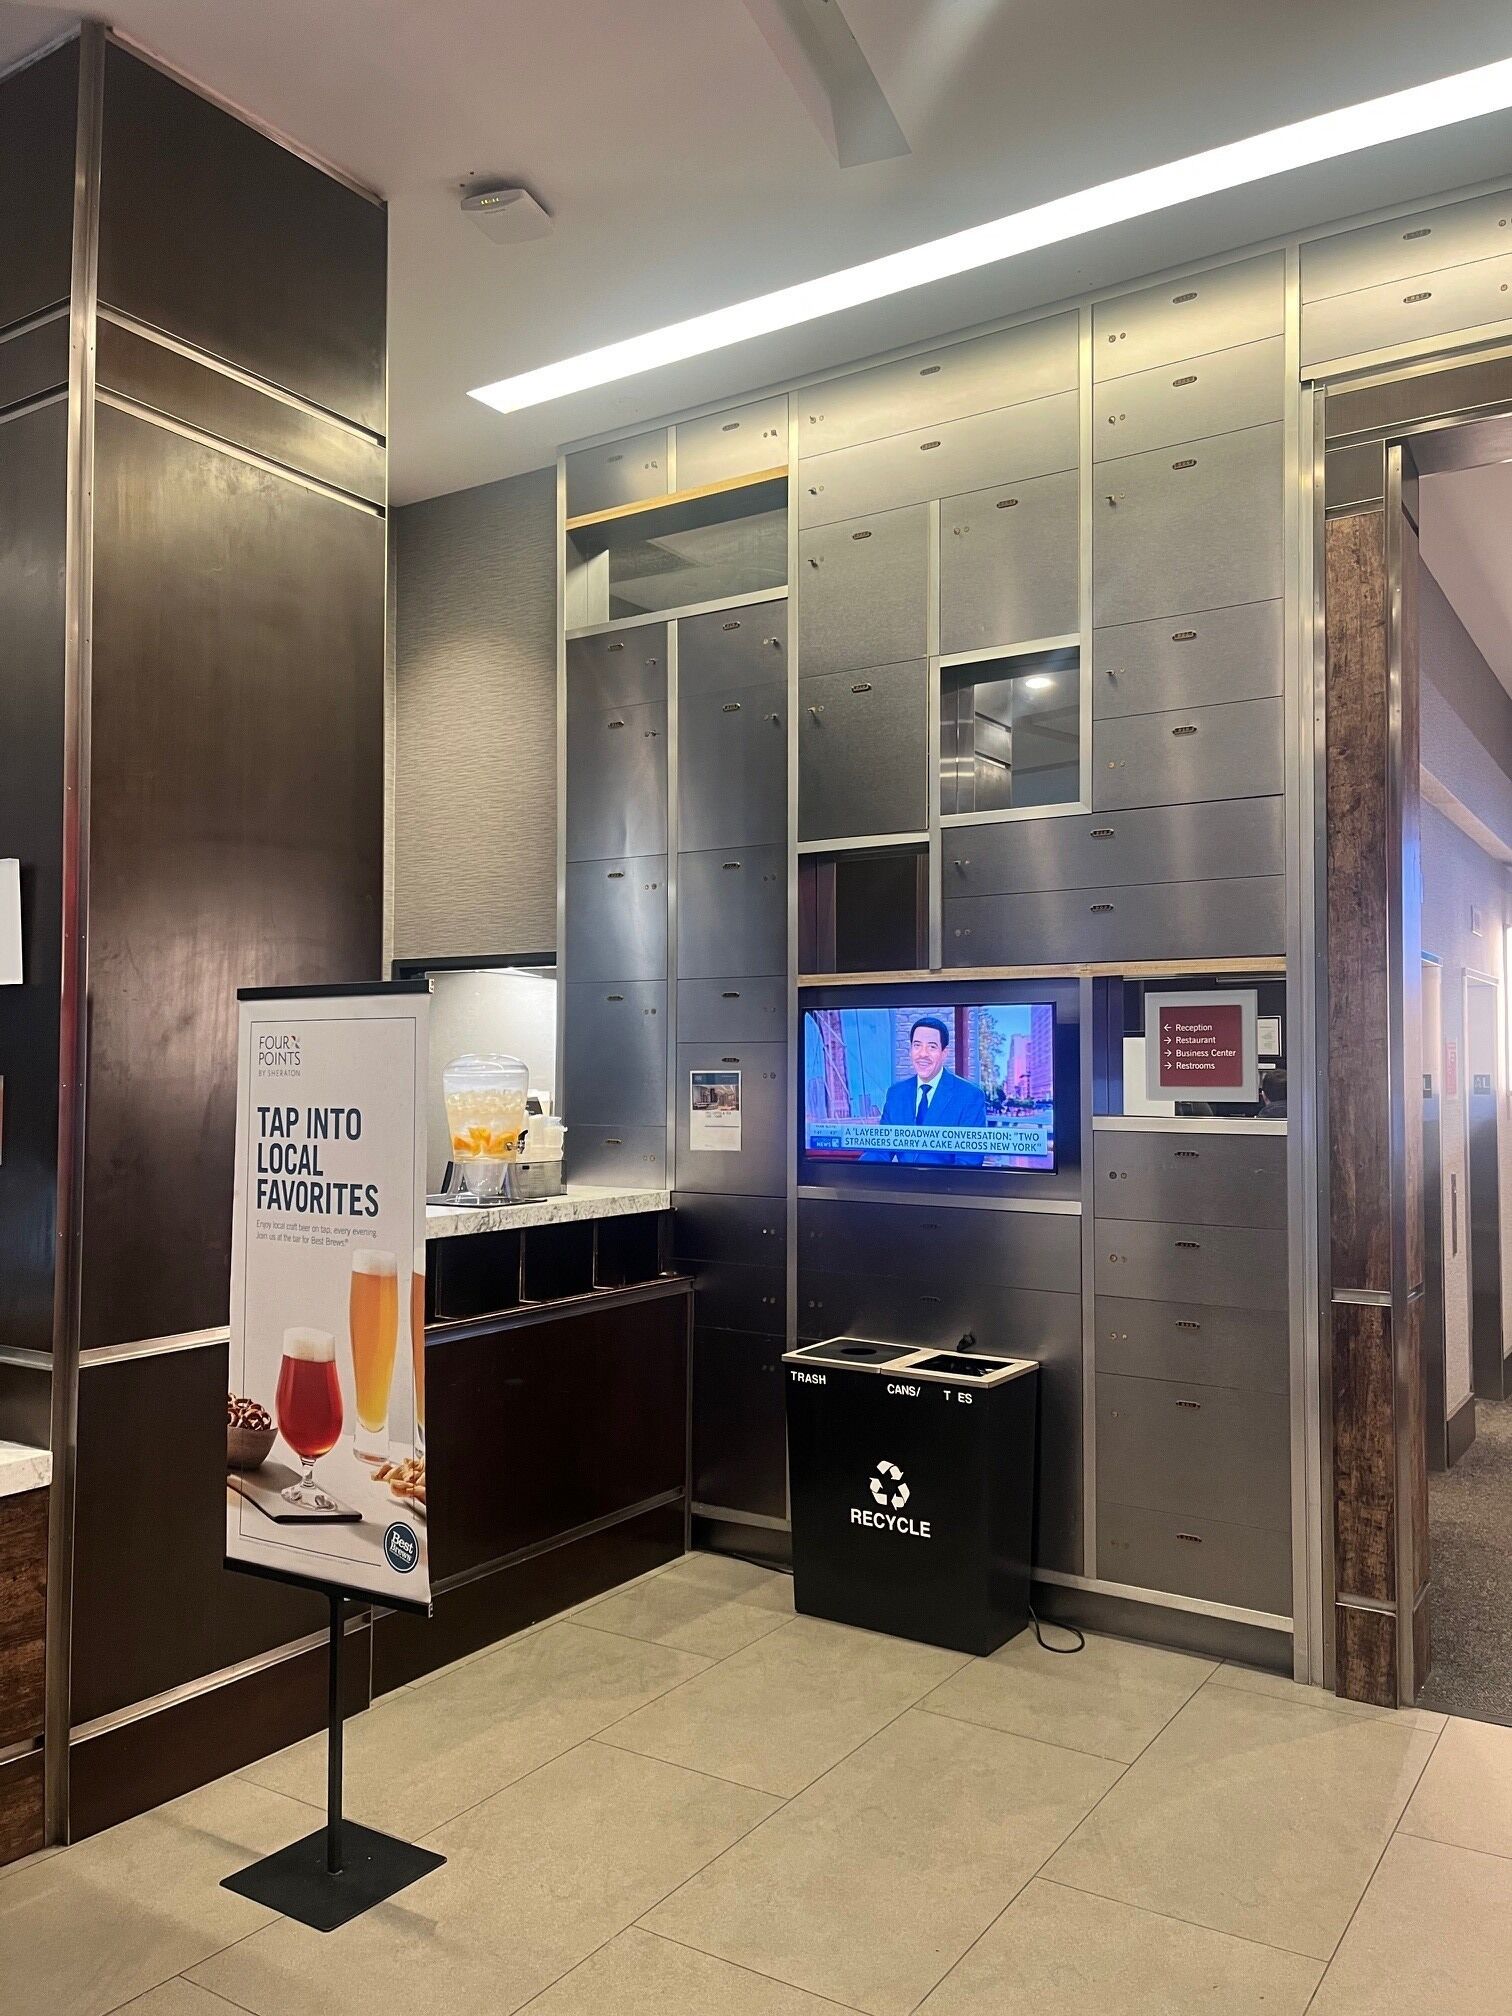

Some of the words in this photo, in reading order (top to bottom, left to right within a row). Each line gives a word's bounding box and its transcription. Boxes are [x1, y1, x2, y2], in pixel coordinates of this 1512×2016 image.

[1175, 1023, 1213, 1033] Reception
[259, 1035, 290, 1050] FOUR
[1175, 1036, 1216, 1044] Restaurant
[258, 1051, 301, 1066] POINTS
[1175, 1049, 1209, 1057] Business
[1211, 1049, 1236, 1057] Center
[1176, 1061, 1216, 1070] Restrooms
[258, 1069, 265, 1077] BY
[267, 1069, 301, 1078] SHERATON
[257, 1106, 299, 1138] TAP
[306, 1107, 362, 1141] INTO
[845, 1128, 851, 1136] A
[894, 1129, 940, 1139] BROADWAY
[942, 1130, 1012, 1141] CONVERSATION:
[845, 1137, 891, 1147] STRANGERS
[893, 1139, 919, 1148] CARRY
[921, 1140, 928, 1148] A
[930, 1140, 952, 1149] CAKE
[954, 1141, 988, 1150] ACROSS
[990, 1142, 1010, 1151] NEW
[257, 1142, 324, 1177] LOCAL
[257, 1178, 379, 1218] FAVORITES
[256, 1220, 271, 1230] Enjoy
[273, 1220, 285, 1230] local
[286, 1222, 297, 1231] craft
[299, 1223, 310, 1232] beer
[333, 1228, 351, 1236] every
[283, 1233, 291, 1242] the
[293, 1235, 301, 1243] bar
[302, 1235, 310, 1244] for
[311, 1236, 324, 1245] Best
[790, 1371, 827, 1385] TRASH
[887, 1383, 921, 1397] CANS/
[850, 1508, 931, 1538] RECYCLE
[392, 1530, 413, 1554] Best
